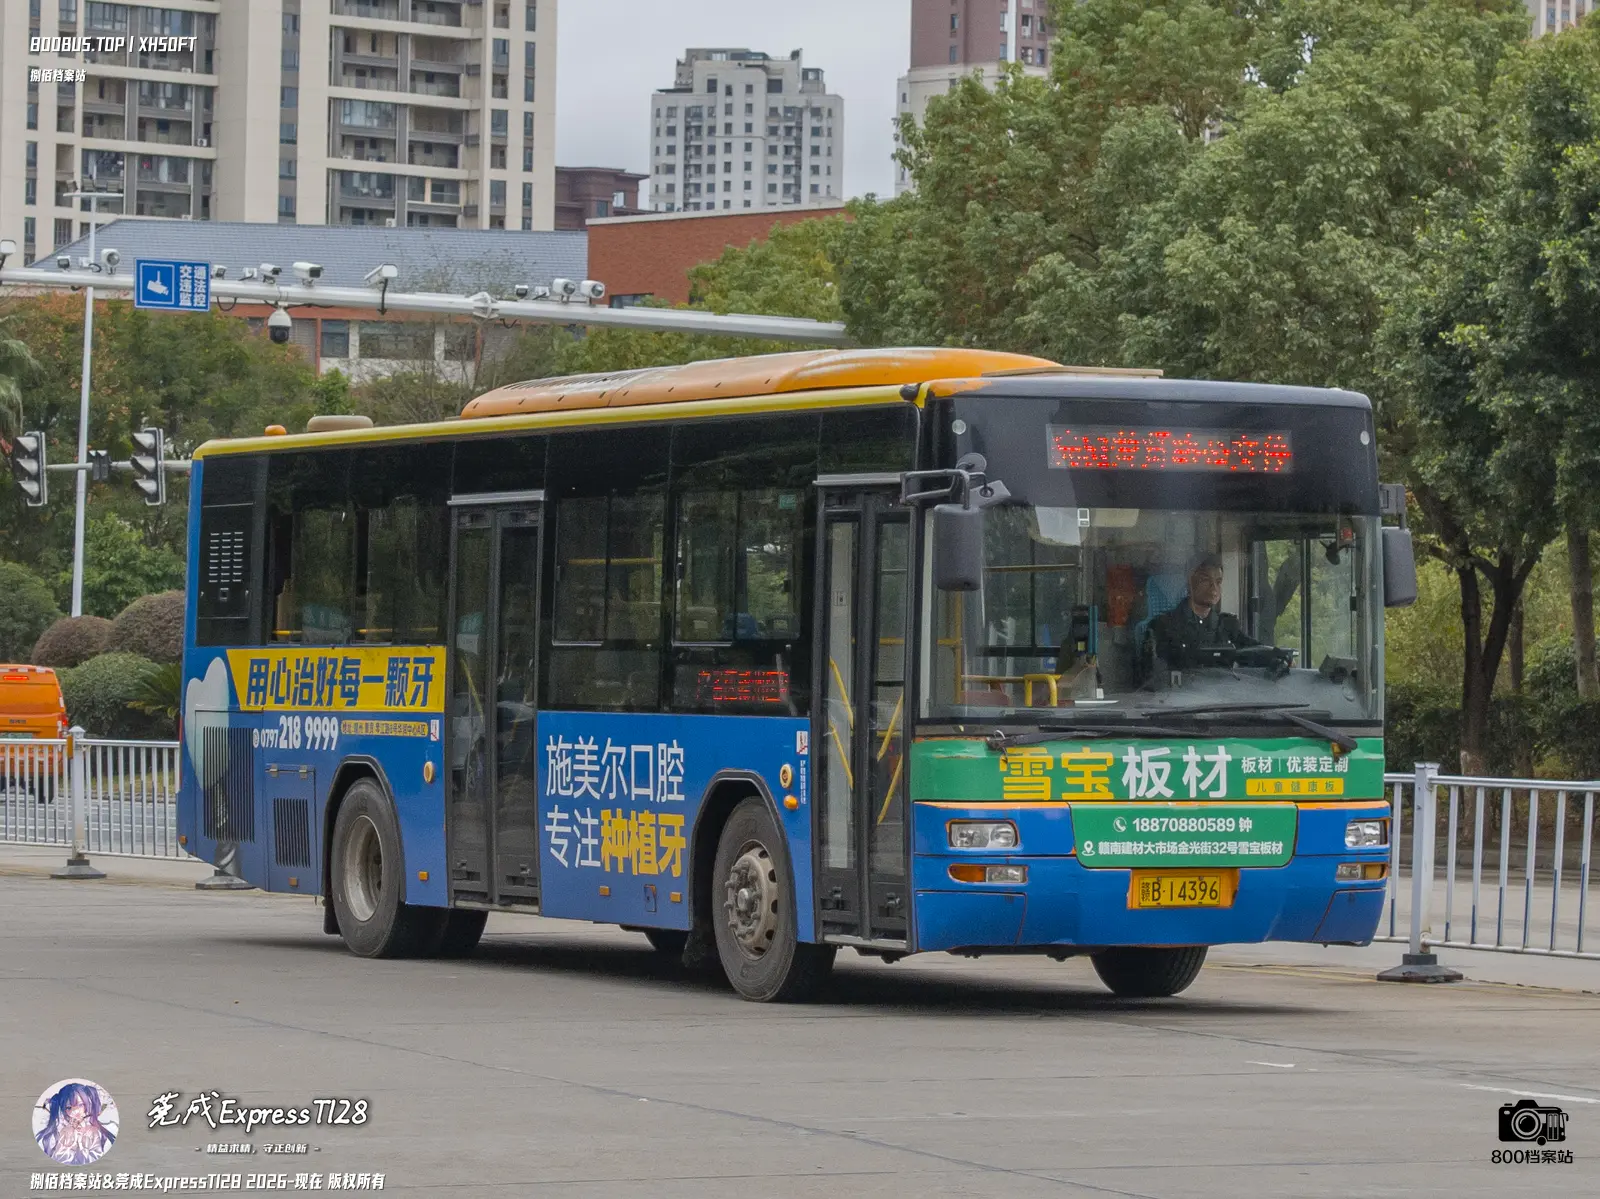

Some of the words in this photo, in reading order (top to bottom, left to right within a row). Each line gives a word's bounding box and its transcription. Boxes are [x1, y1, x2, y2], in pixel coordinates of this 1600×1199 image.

[179, 265, 207, 279] 交通
[179, 279, 207, 293] 违法
[246, 656, 435, 708] 用心治好每一颗牙
[279, 716, 301, 749] 218
[305, 716, 339, 750] 9999
[545, 735, 686, 803] 施美尔口腔
[999, 745, 1232, 801] 雪宝板材
[1241, 756, 1272, 773] 板材
[1286, 756, 1349, 773] 优装定制
[1255, 780, 1335, 793] 儿童健康板
[1132, 817, 1236, 833] 18870880589
[1238, 817, 1253, 833] 钟
[545, 804, 687, 878] 专注种植牙
[1098, 841, 1284, 856] 赣南建材大市场金光街32号雪宝板材
